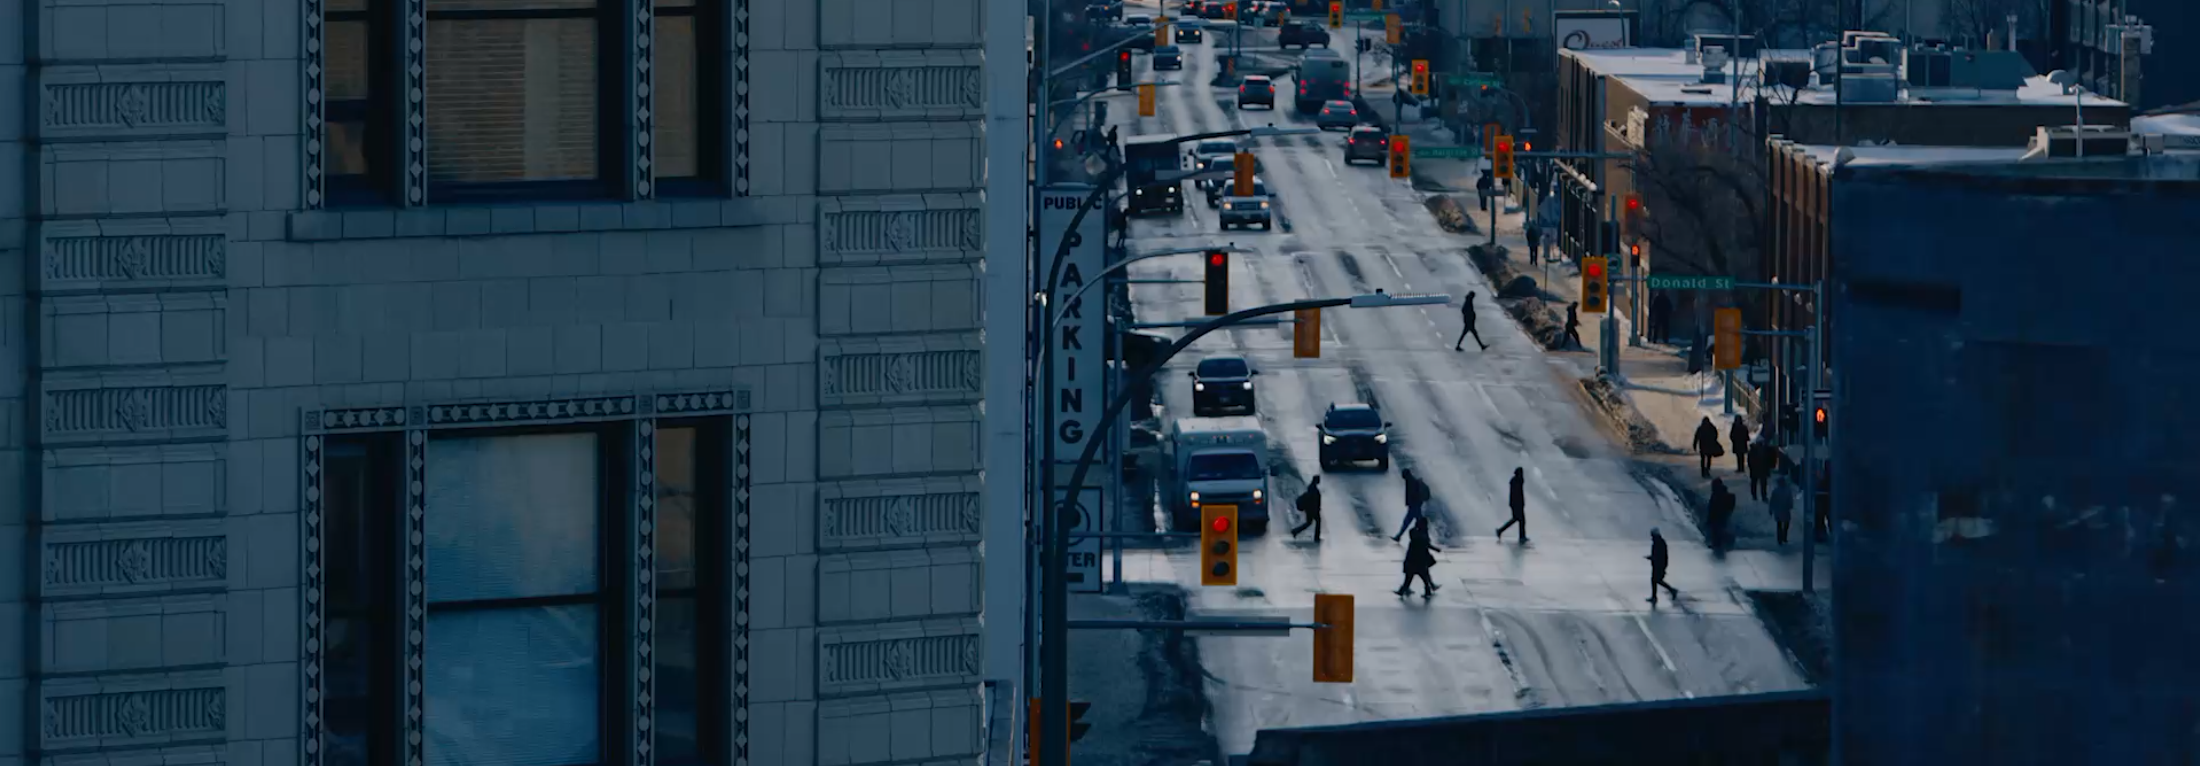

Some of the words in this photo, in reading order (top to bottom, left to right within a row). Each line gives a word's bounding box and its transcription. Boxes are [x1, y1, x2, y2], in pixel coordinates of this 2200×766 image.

[1044, 196, 1103, 210] PUBLC
[1651, 278, 1706, 289] Donald
[1716, 279, 1730, 289] St
[1059, 231, 1084, 444] PARKING
